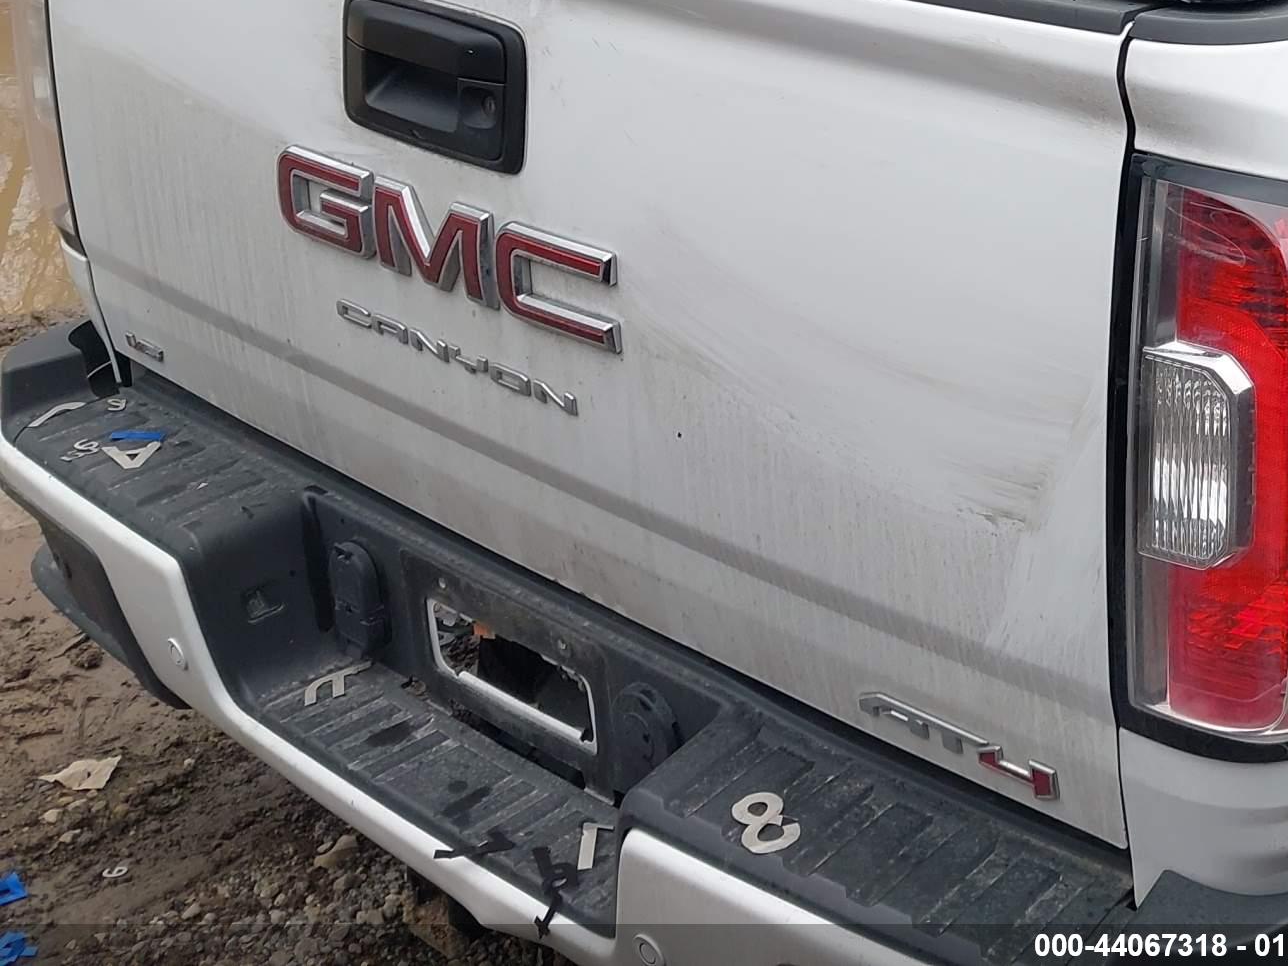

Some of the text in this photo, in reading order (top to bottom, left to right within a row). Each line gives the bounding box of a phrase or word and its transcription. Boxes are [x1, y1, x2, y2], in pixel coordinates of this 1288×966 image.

[276, 144, 622, 355] GMC
[336, 298, 578, 416] CANYON
[858, 691, 1060, 802] AT4
